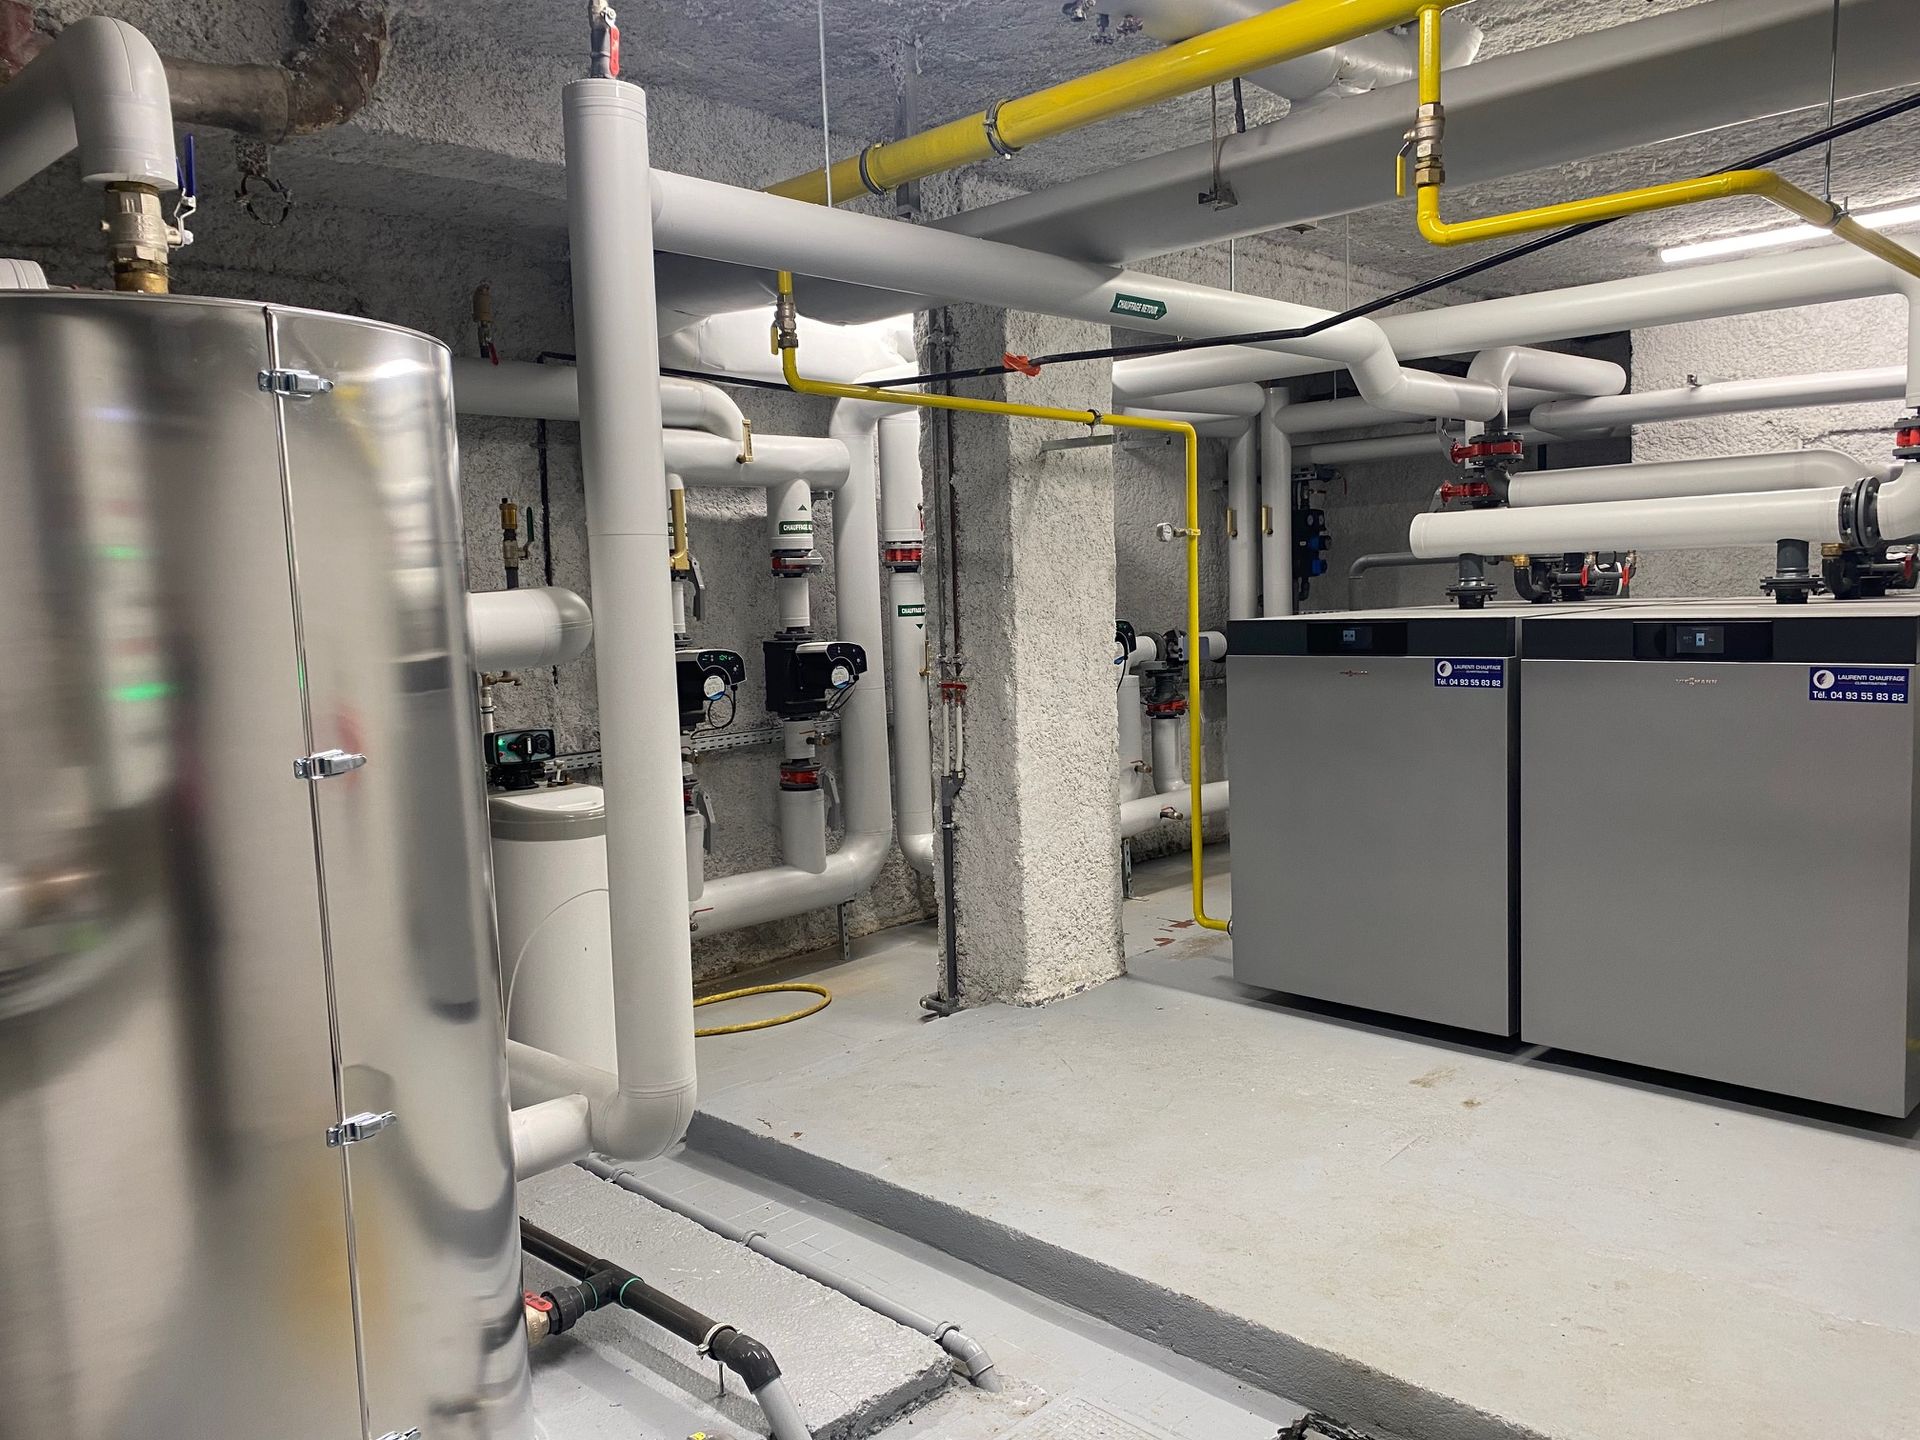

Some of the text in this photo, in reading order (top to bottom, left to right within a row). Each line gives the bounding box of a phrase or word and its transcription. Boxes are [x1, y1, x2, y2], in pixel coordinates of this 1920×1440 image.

[1117, 300, 1142, 312] CHAUFFAGE
[1812, 690, 1905, 702] Tél. 04 93 55 83 82
